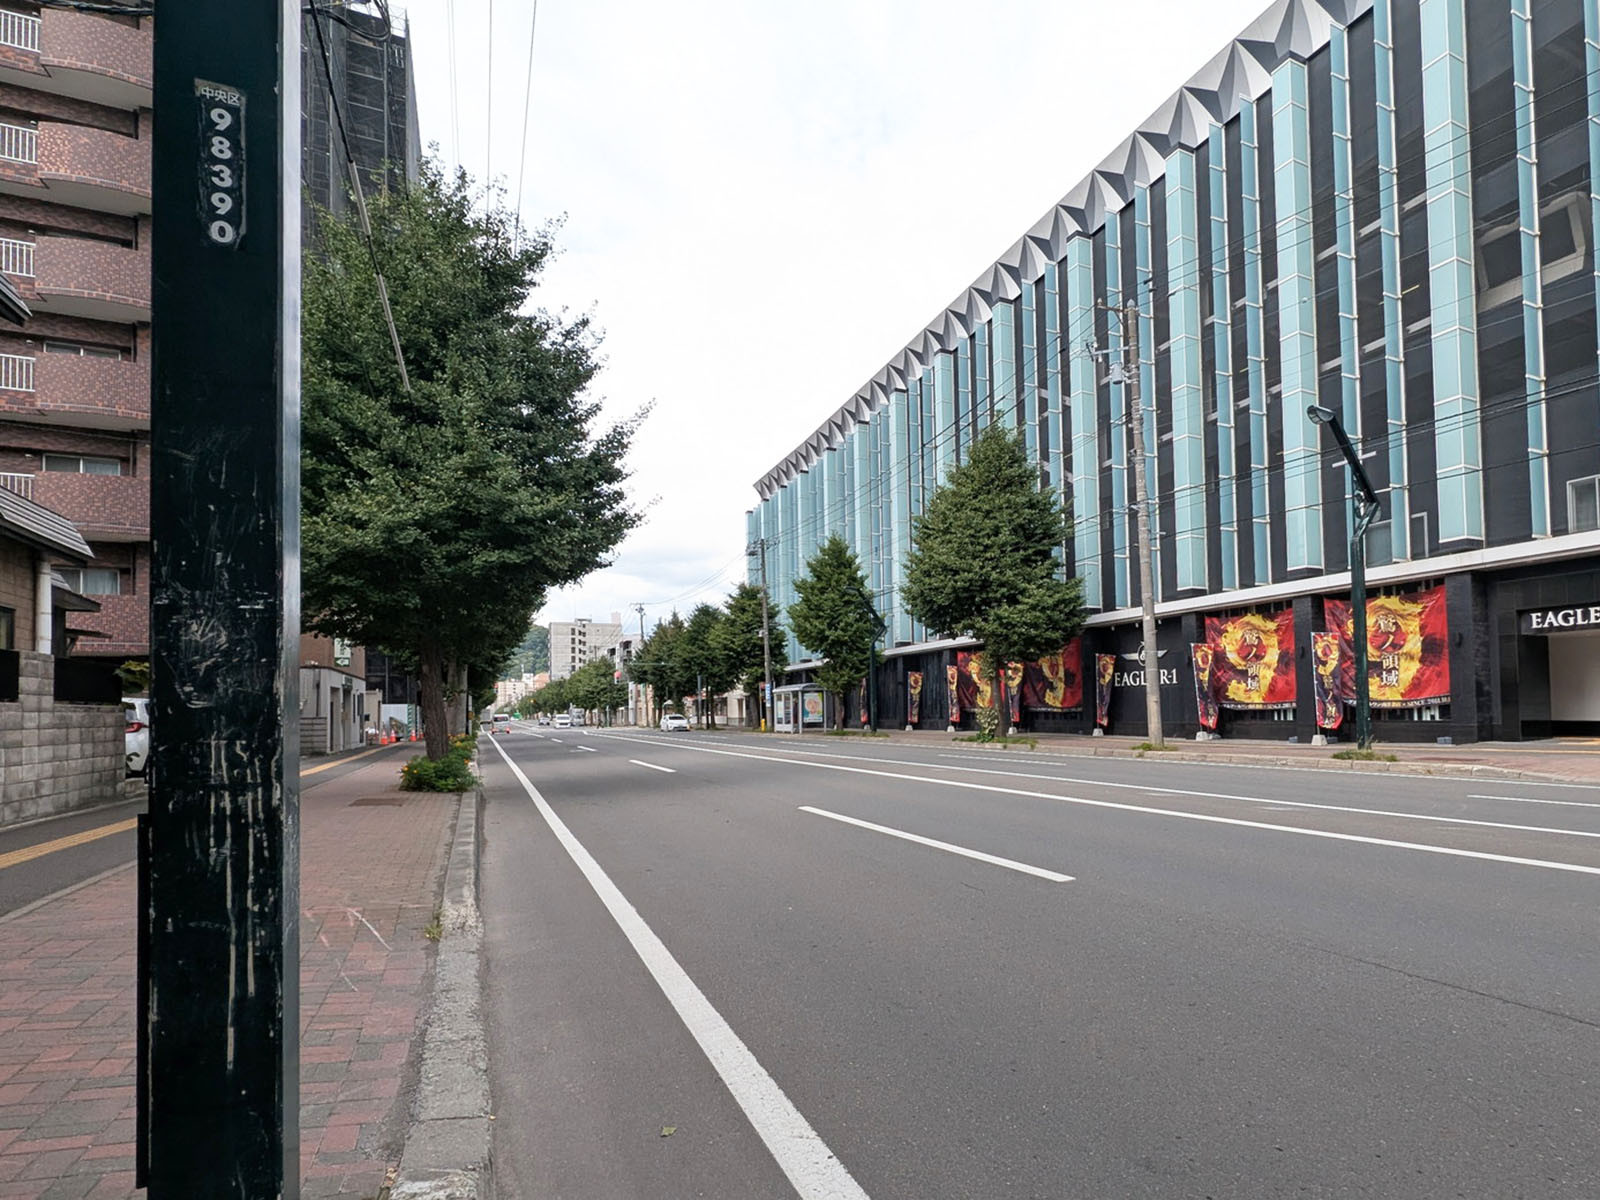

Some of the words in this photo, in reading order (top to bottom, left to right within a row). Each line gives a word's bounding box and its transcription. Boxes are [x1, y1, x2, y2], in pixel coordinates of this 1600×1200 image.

[201, 86, 240, 106] 中央区
[209, 107, 234, 243] 98390
[1530, 606, 1600, 629] EAGLE
[1114, 668, 1178, 687] EAGLR-1
